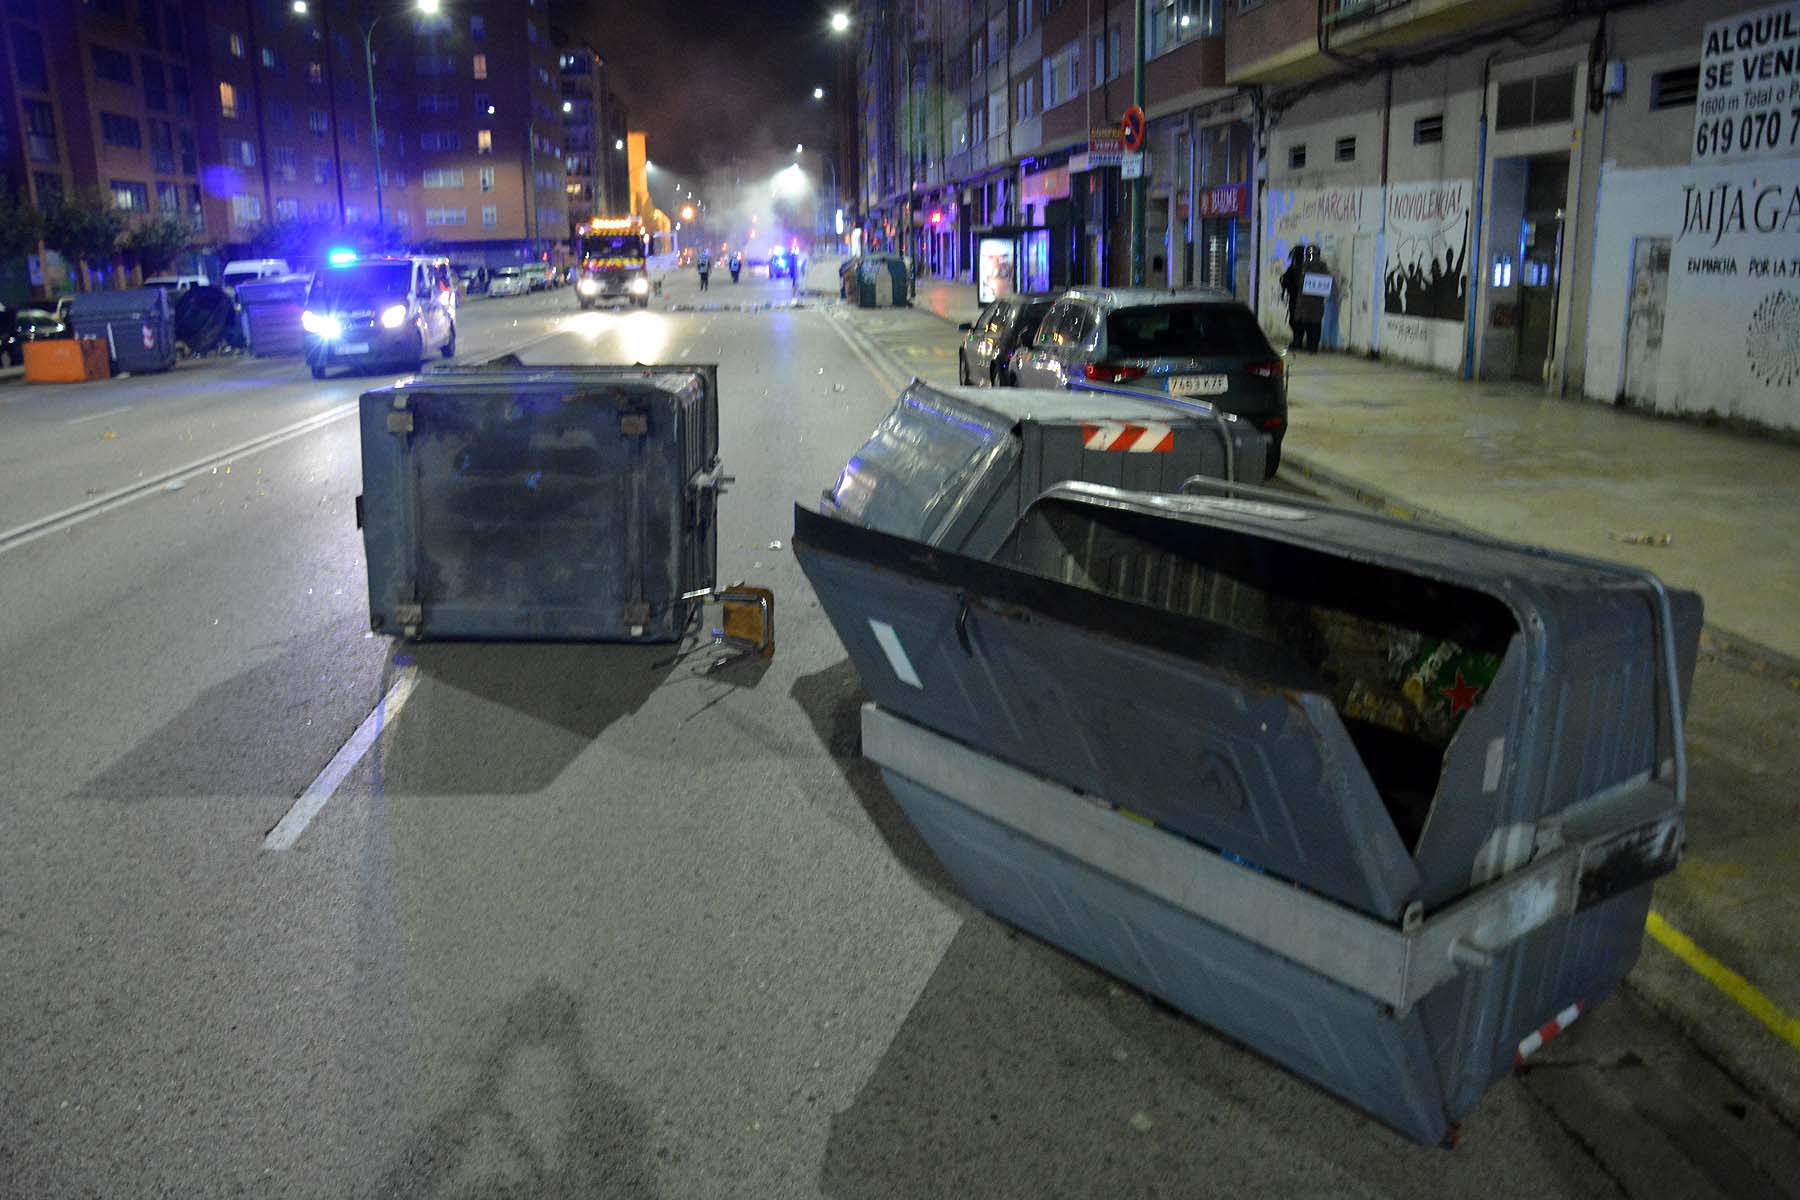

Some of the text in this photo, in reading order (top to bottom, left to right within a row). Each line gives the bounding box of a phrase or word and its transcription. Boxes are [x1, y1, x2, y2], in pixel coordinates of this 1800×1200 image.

[1705, 11, 1800, 58] ALQUIL
[1704, 61, 1734, 91] SE
[1744, 87, 1772, 108] Total
[1697, 116, 1733, 157] 619
[1740, 110, 1781, 152] 070
